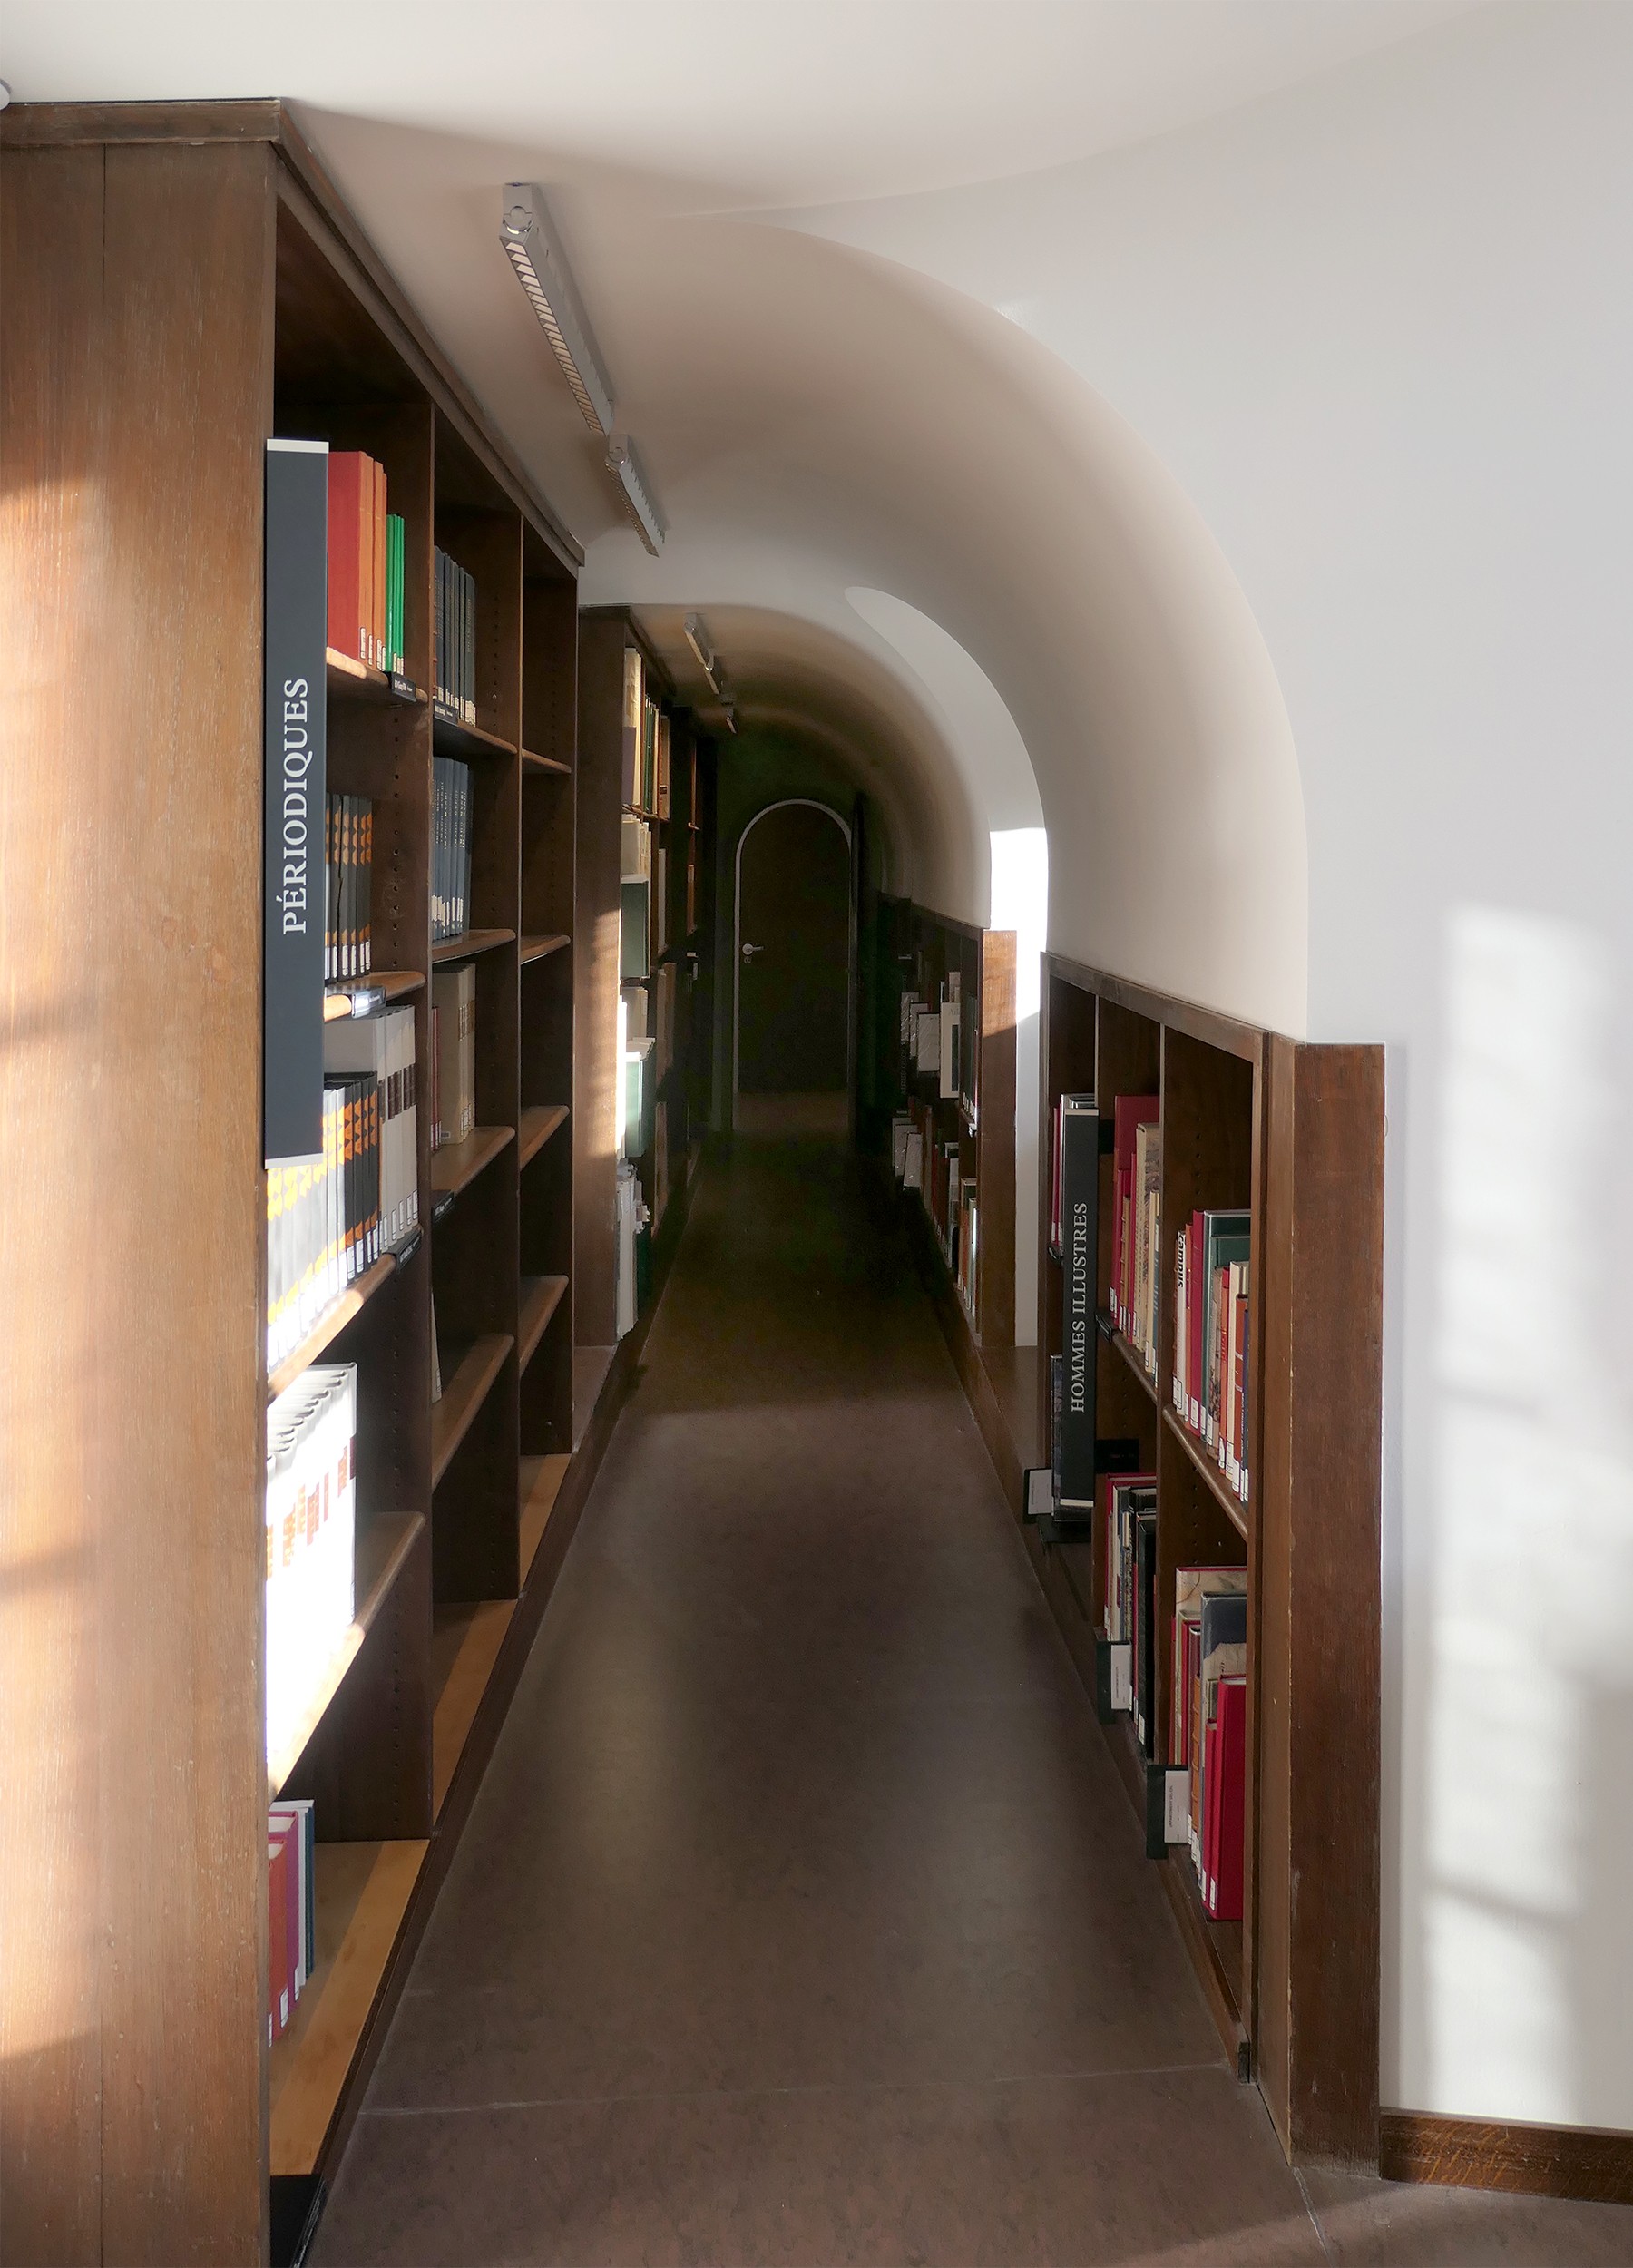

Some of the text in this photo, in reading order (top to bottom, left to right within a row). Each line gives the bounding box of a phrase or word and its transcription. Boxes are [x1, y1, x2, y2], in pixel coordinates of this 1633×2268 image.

[276, 678, 314, 935] PÉRIODIQUES
[1071, 1202, 1088, 1413] HOMMES ILLUSTRES
